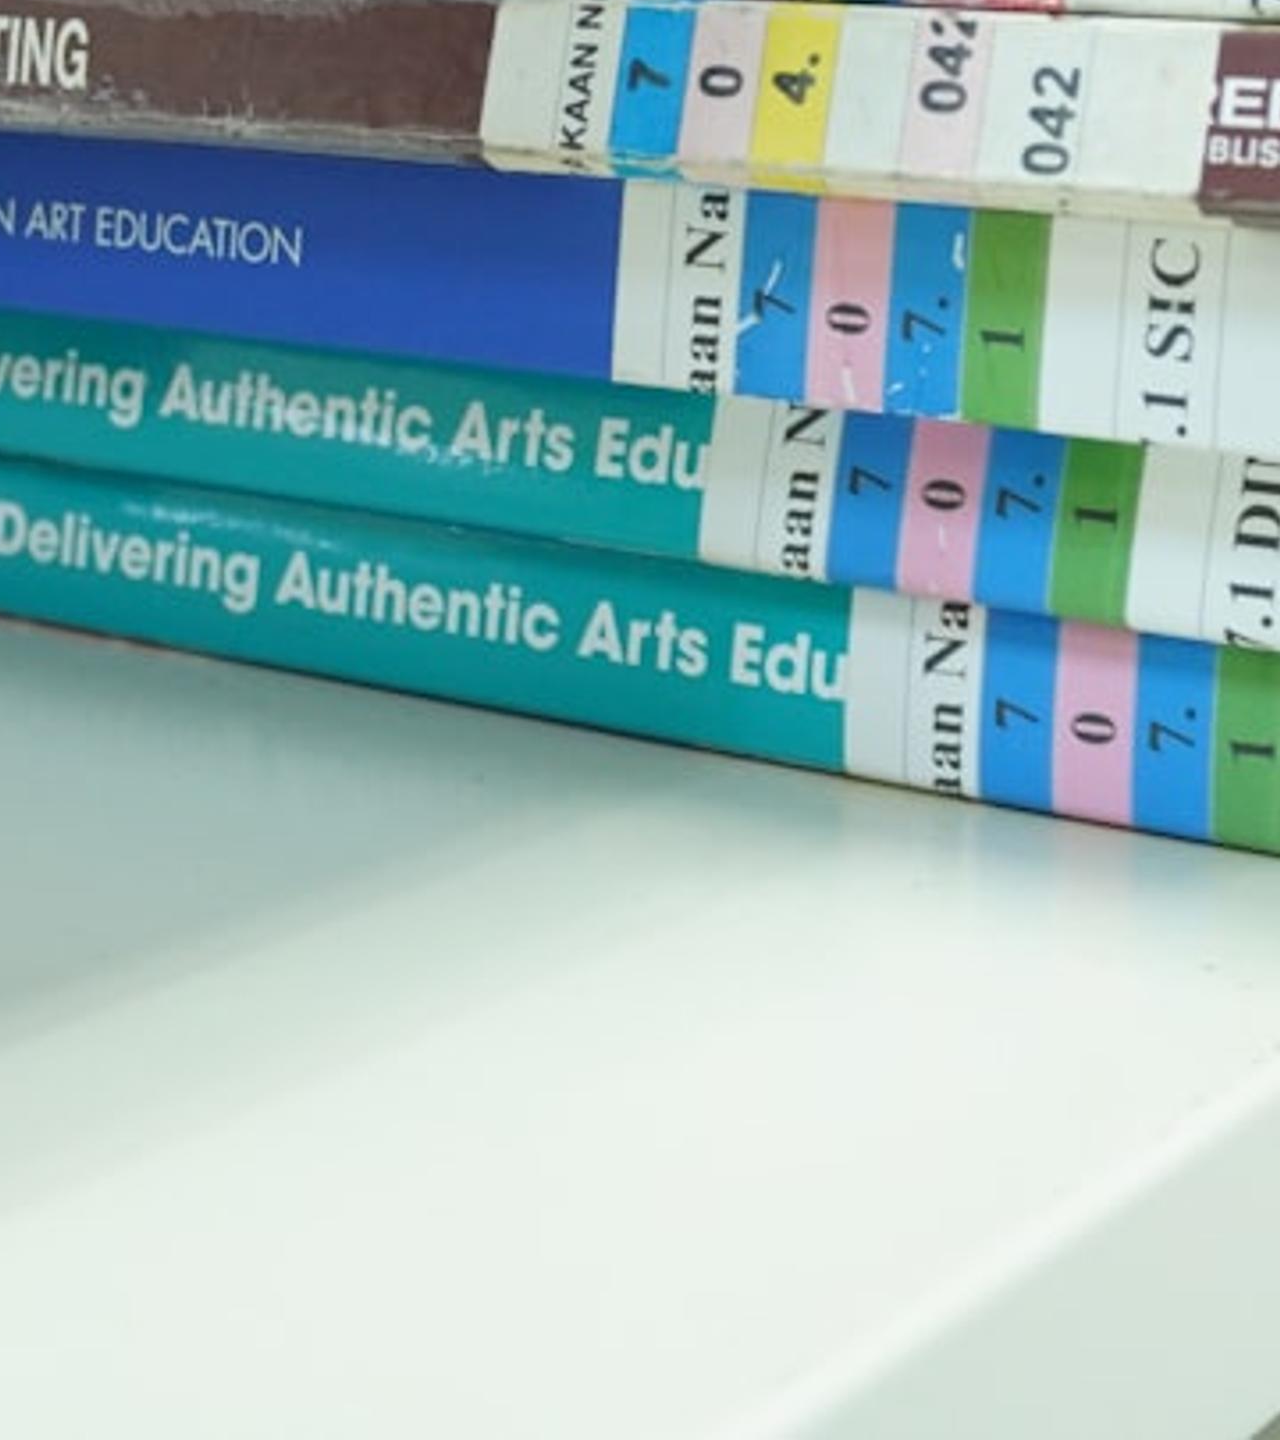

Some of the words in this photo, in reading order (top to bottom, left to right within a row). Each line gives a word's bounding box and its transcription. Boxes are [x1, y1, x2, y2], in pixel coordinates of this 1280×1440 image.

[627, 59, 672, 92] 7
[699, 65, 744, 98] 0
[771, 53, 820, 105] 4.
[919, 14, 978, 113] 042
[560, 41, 600, 170] KAAN
[1022, 67, 1080, 176] 042
[25, 201, 85, 245] ART
[95, 206, 303, 267] EDUCATION
[684, 191, 730, 270] Na
[753, 289, 796, 320] 7
[826, 302, 871, 335] 0
[902, 296, 949, 343] 7.
[1145, 237, 1200, 362] SIC
[981, 326, 1025, 352] 1
[158, 361, 431, 454] Authentic
[451, 401, 576, 471] Arts
[594, 417, 707, 491] Edu
[1142, 393, 1188, 444] .1
[848, 466, 893, 496] 7
[921, 479, 966, 511] 0
[996, 474, 1045, 520] 7.
[1073, 506, 1119, 530] 1
[275, 551, 560, 652] Authentic
[577, 600, 709, 678] Arts
[729, 622, 850, 703] Edu
[923, 600, 971, 678] Na
[995, 698, 1039, 730] 7
[1071, 712, 1117, 745] 0
[1149, 707, 1197, 753] 7.
[1229, 739, 1276, 759] 1
